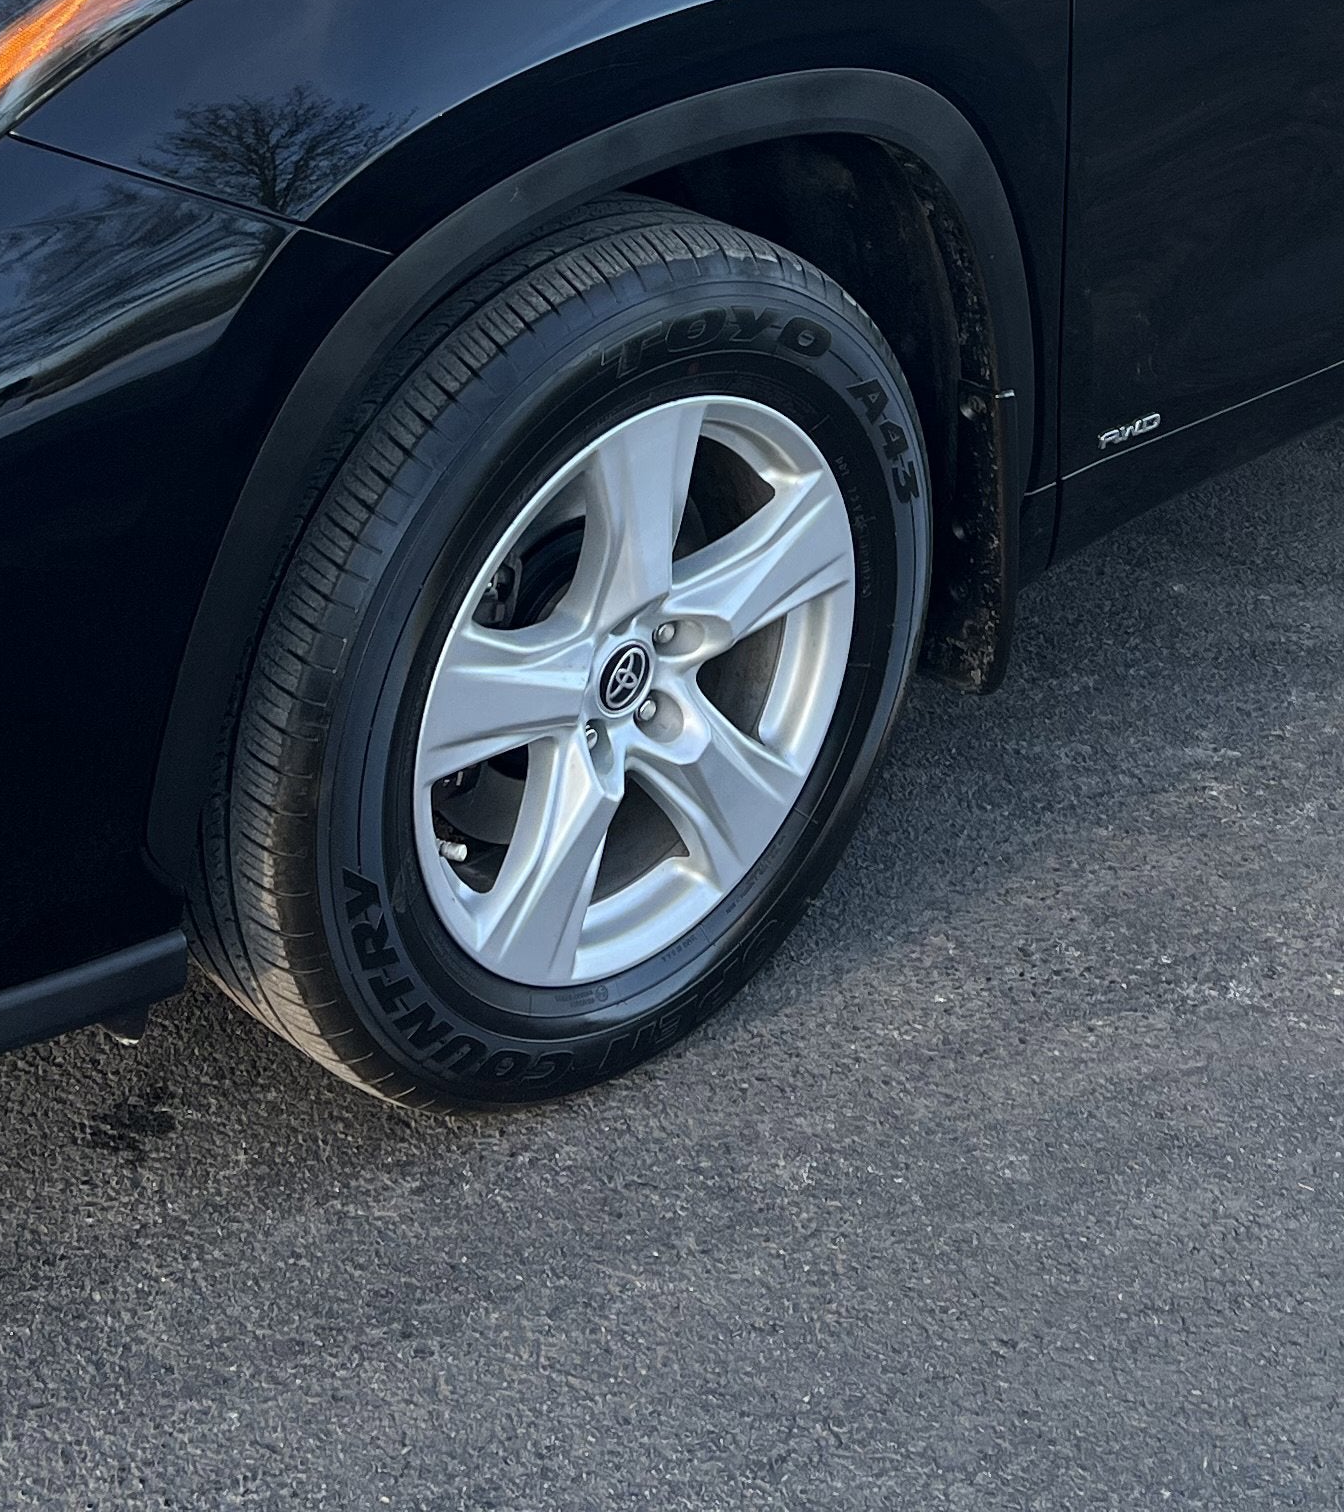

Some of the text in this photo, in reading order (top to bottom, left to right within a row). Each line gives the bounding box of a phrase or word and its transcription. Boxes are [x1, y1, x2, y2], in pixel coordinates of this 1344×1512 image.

[600, 305, 921, 505] TOYO A43
[1097, 413, 1161, 450] AWD
[341, 866, 575, 1085] COUNTRY
